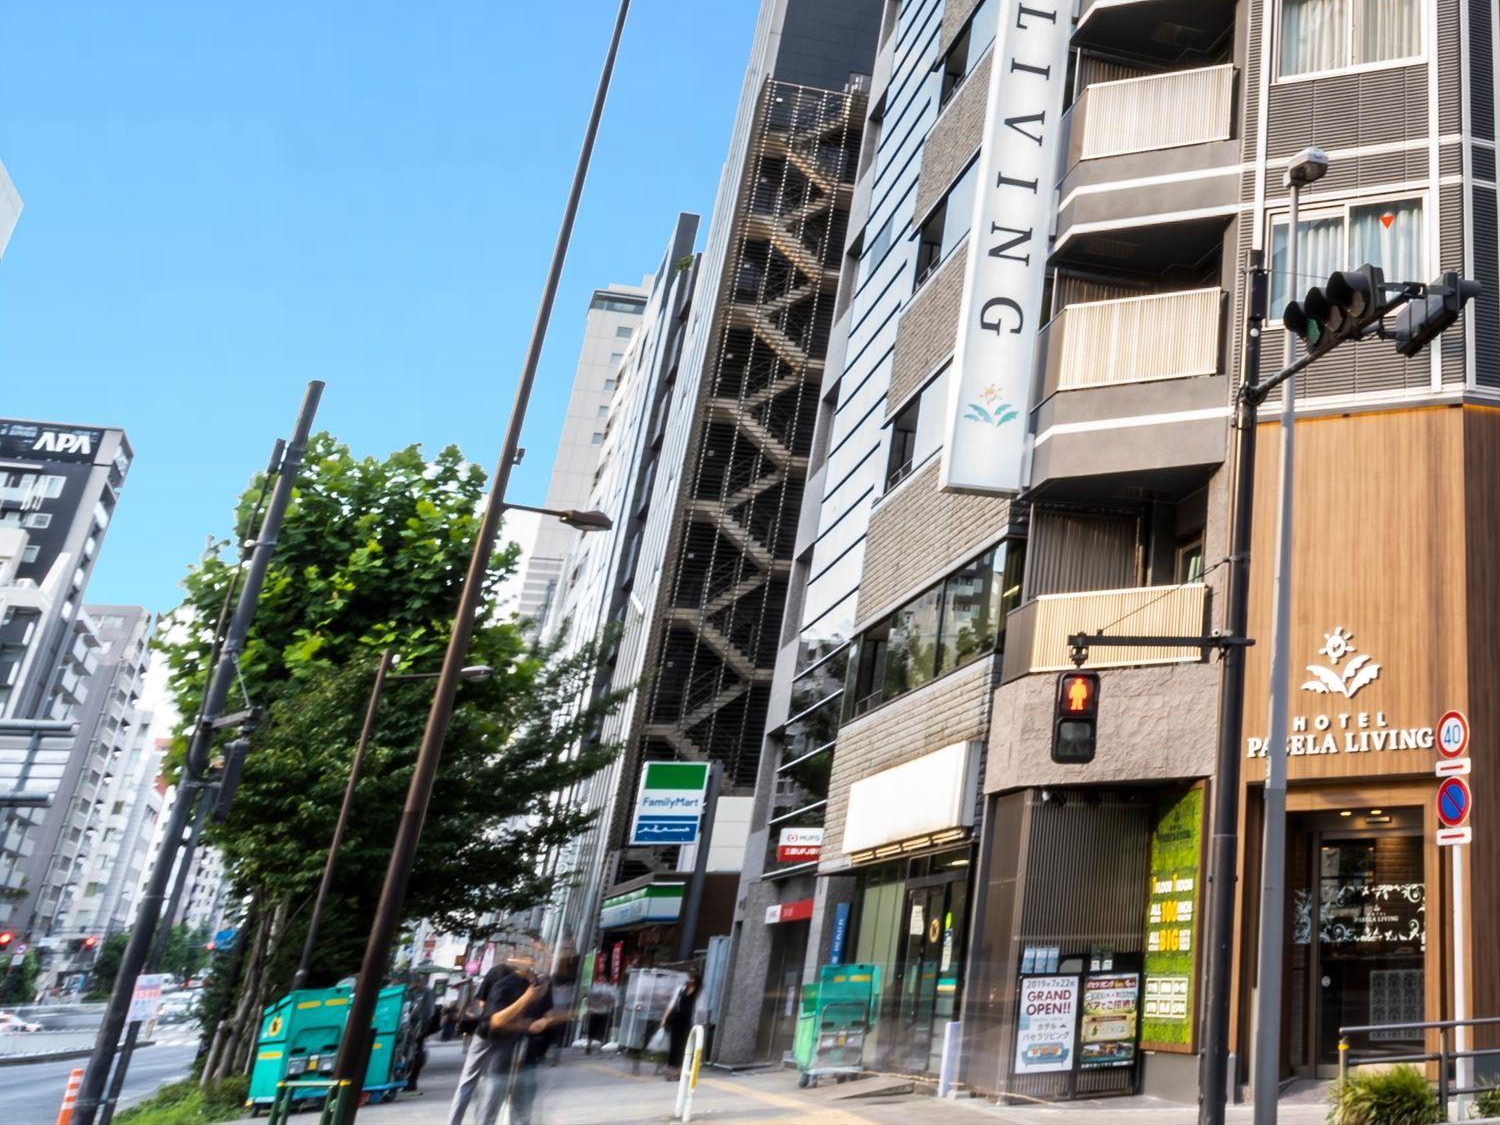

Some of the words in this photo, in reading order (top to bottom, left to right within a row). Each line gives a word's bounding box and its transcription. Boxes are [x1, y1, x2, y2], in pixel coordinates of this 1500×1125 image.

[979, 1, 1059, 337] LIVING
[32, 431, 92, 455] APA
[1292, 711, 1388, 732] HOTEL
[1344, 727, 1434, 754] LIVING
[1443, 722, 1462, 746] 40
[642, 796, 699, 810] FamilyMart
[1159, 929, 1179, 951] BIG
[1027, 990, 1072, 1003] GRAND
[1026, 1002, 1071, 1016] OPEN!!
